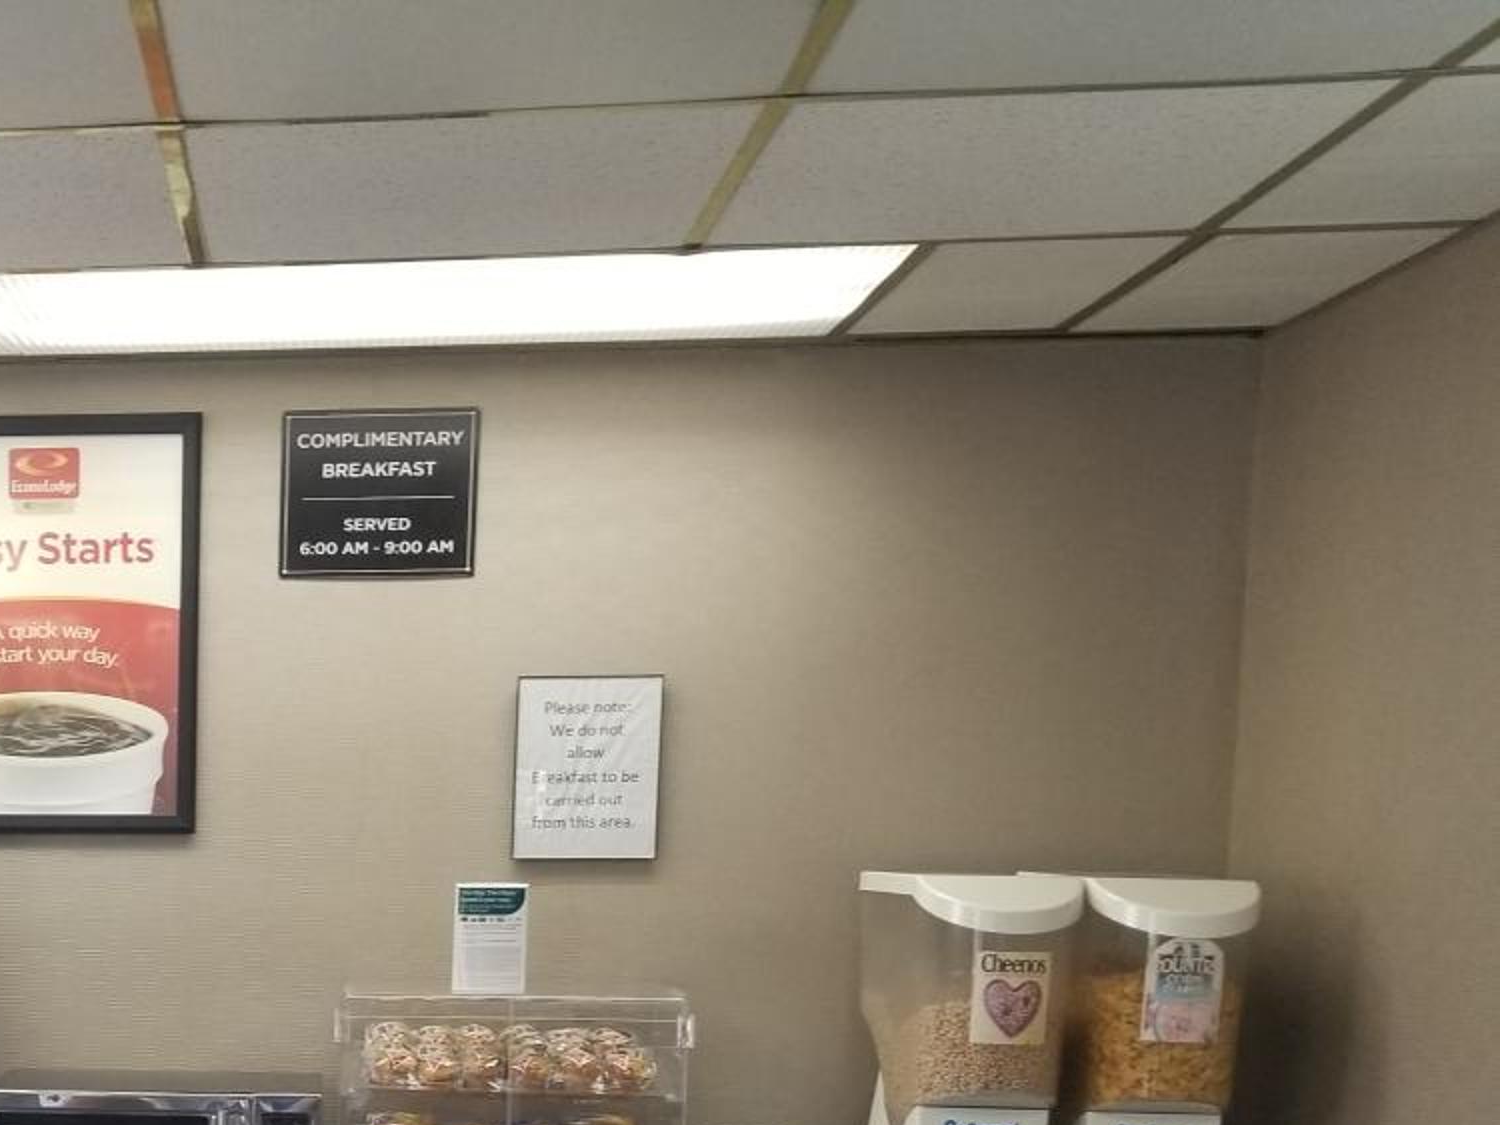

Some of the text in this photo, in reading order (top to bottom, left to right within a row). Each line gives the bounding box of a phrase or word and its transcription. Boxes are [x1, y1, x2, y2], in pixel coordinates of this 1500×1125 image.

[296, 430, 465, 449] COMPLIMENTARY
[321, 461, 437, 479] BREAKFAST
[343, 517, 411, 531] SERVED
[37, 531, 154, 565] Starts
[299, 541, 338, 556] 6:00
[341, 541, 369, 555] AM
[383, 540, 423, 555] 9:00
[426, 539, 455, 553] AM
[8, 621, 59, 641] quick
[62, 625, 100, 643] way
[37, 647, 80, 665] your
[544, 701, 590, 715] Please
[549, 724, 625, 737] We do not
[566, 745, 605, 759] allow
[601, 771, 618, 783] to
[621, 770, 640, 783] be
[598, 794, 624, 806] out
[531, 815, 567, 830] from
[570, 815, 596, 829] this
